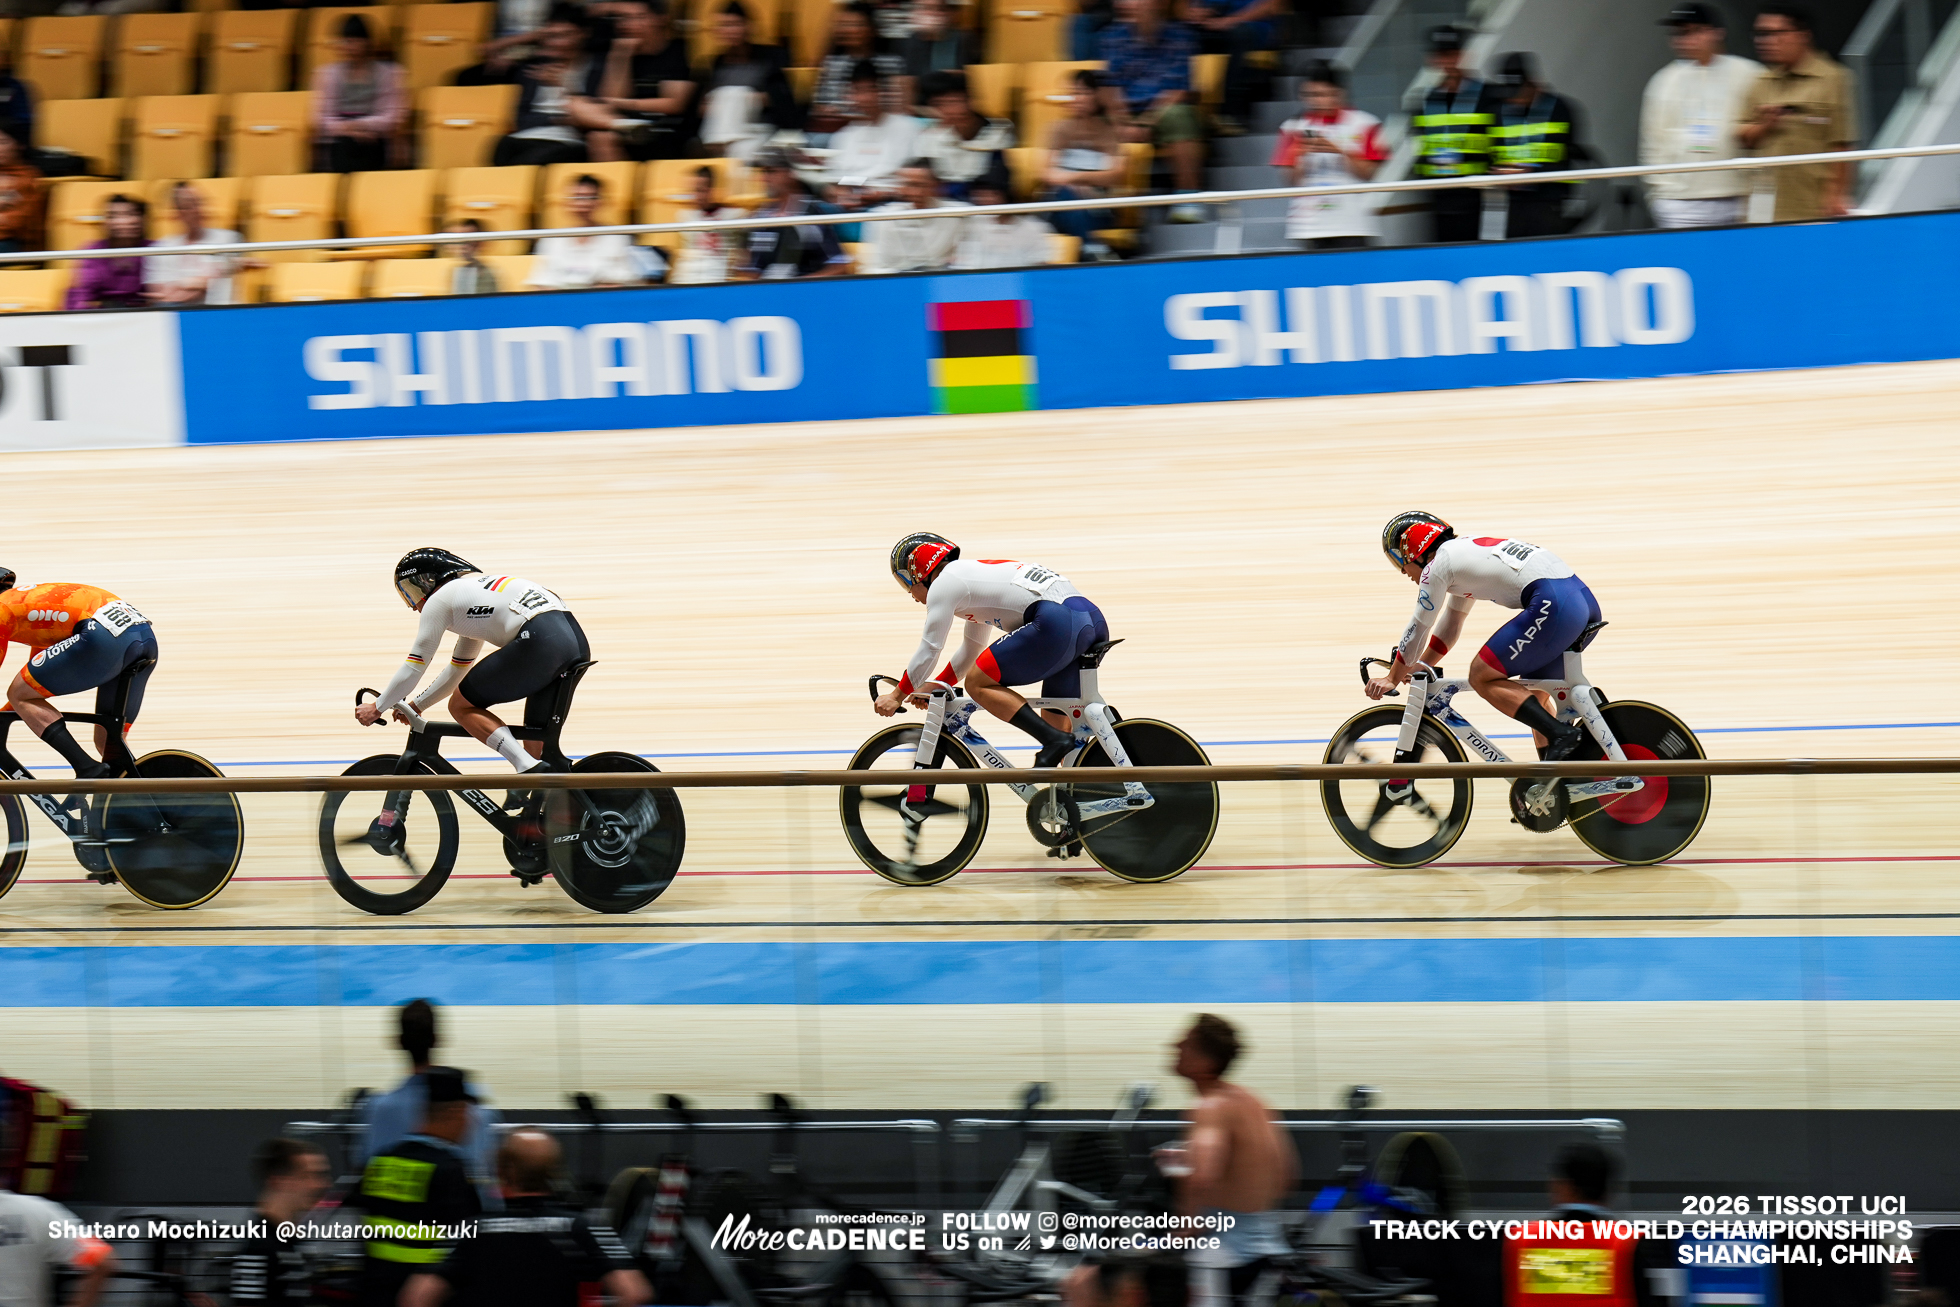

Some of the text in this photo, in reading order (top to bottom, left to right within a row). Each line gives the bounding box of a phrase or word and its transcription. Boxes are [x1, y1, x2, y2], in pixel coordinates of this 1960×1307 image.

[1165, 266, 1695, 371] SHIMANO
[304, 315, 802, 411] SHIMANO
[0, 344, 82, 421] T
[1418, 526, 1444, 552] JAPAN
[1501, 542, 1534, 561] 168
[925, 546, 951, 571] JAPAN
[401, 568, 417, 577] CASCO
[466, 605, 495, 615] KTM
[1509, 599, 1552, 660] JAPAN
[462, 789, 499, 815] ES
